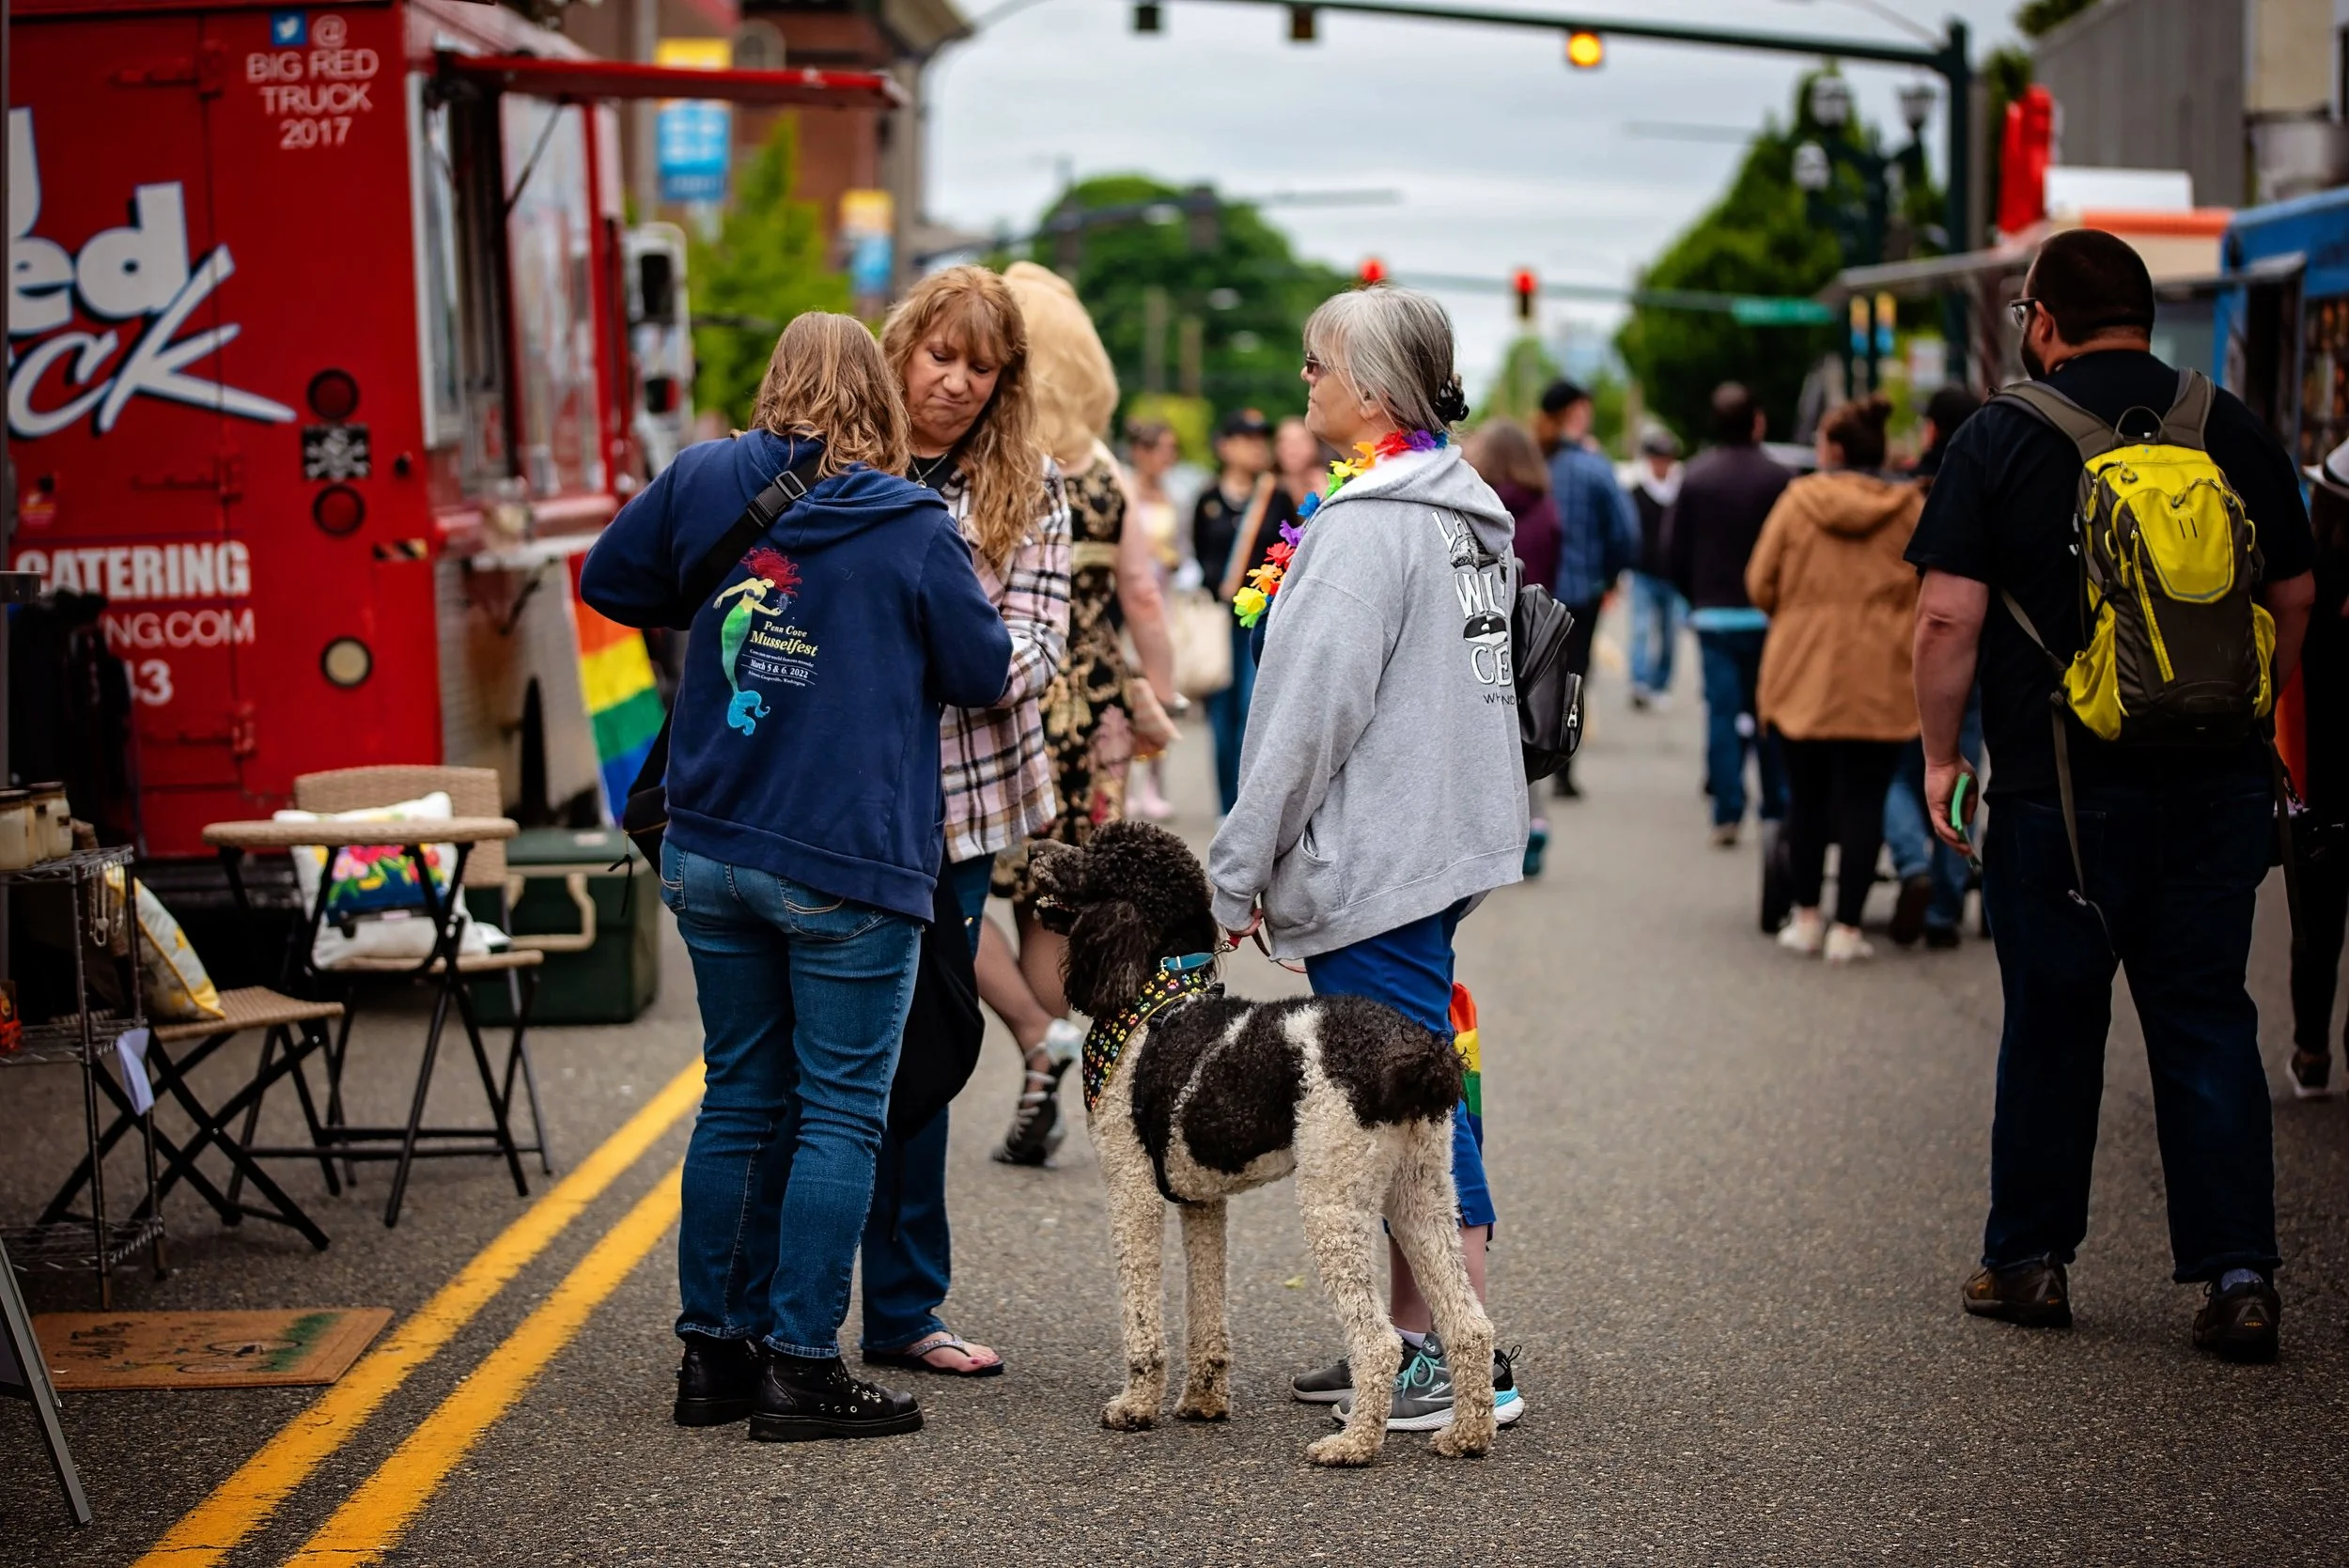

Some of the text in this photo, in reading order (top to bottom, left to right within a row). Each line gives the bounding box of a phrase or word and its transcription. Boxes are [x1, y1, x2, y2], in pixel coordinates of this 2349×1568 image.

[246, 48, 380, 83] BIG RED
[258, 82, 373, 115] TRUCK
[280, 116, 352, 149] 2017
[9, 181, 190, 334] ed
[8, 242, 297, 438] ck
[16, 540, 251, 601] CATERING
[102, 608, 256, 648] NG.COM
[750, 630, 818, 657] Musselfest
[764, 621, 807, 637] Penn Cove
[751, 659, 766, 671] March
[767, 663, 771, 672] 5
[772, 665, 779, 674] &
[789, 668, 808, 678] 2022
